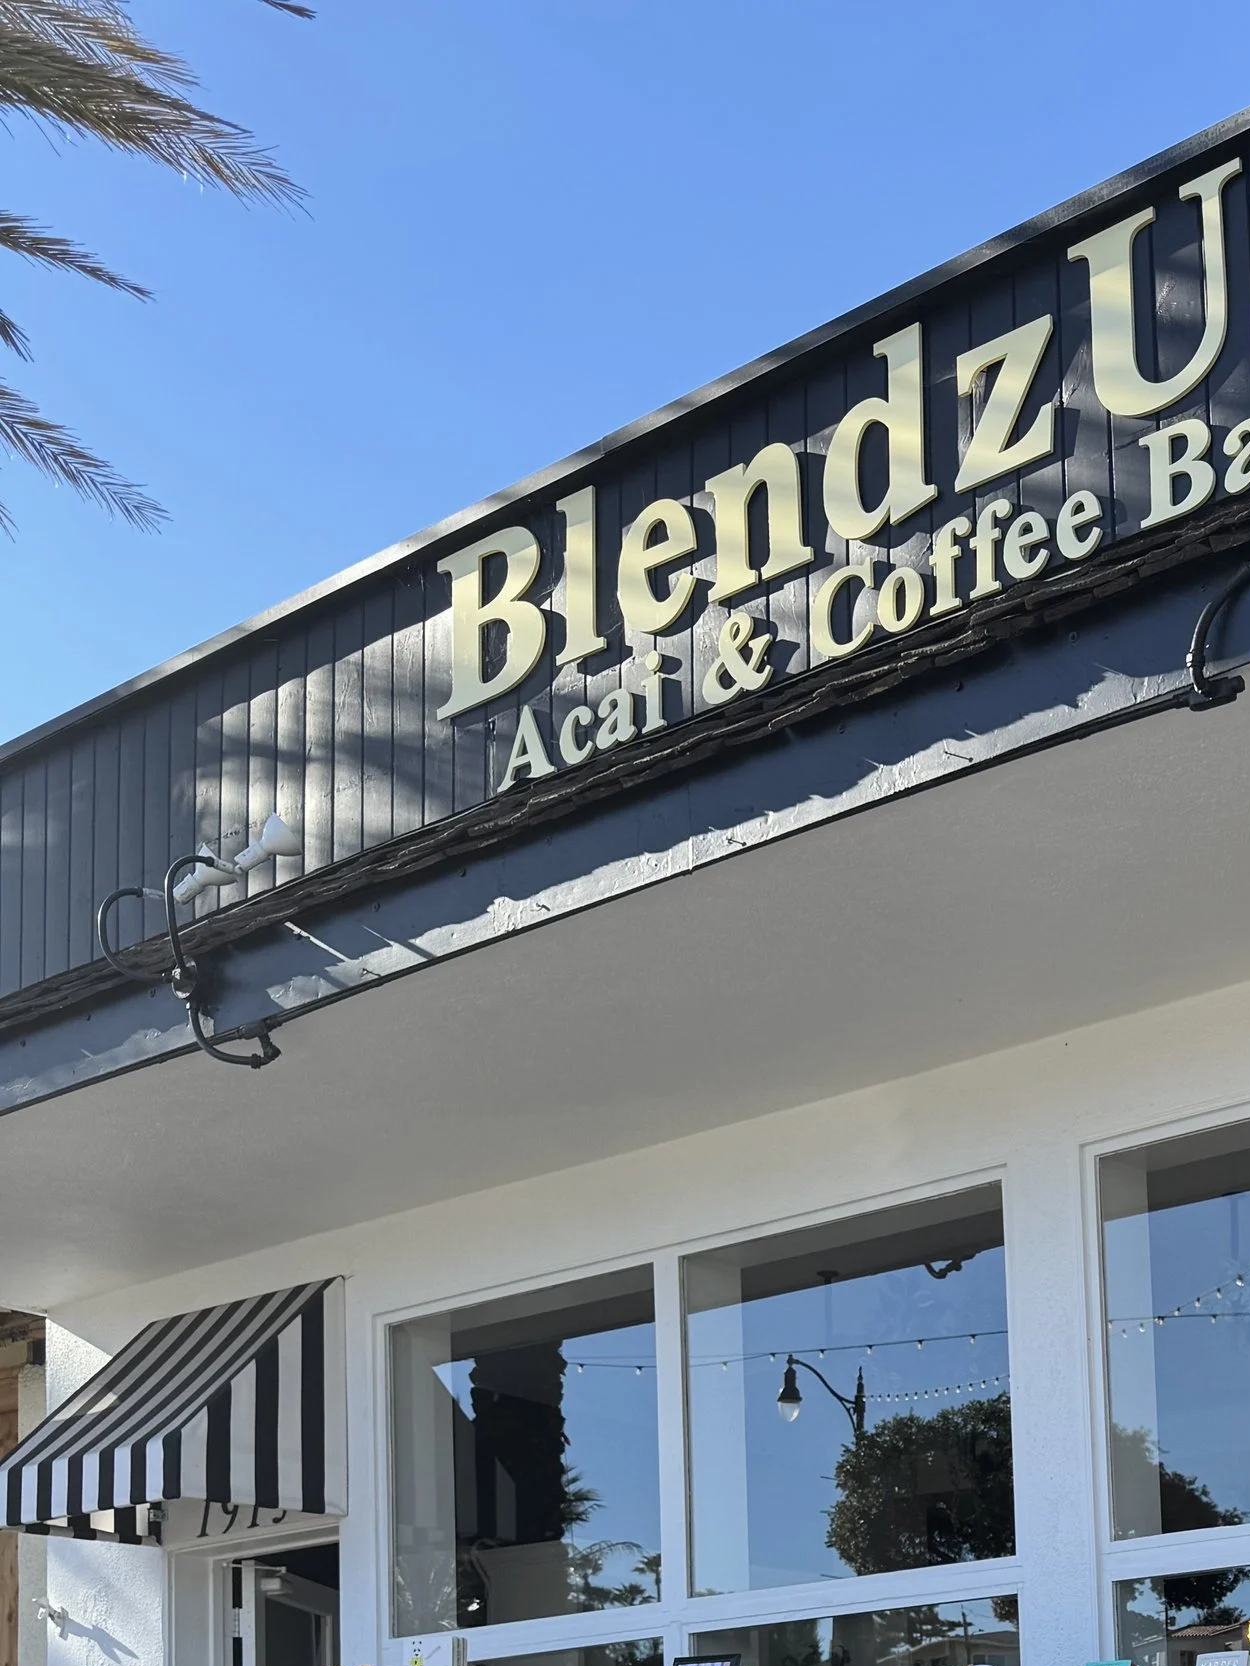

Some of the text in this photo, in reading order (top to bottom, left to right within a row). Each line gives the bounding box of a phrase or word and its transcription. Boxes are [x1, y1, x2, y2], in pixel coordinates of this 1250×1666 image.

[497, 653, 669, 793] Acai
[704, 610, 774, 706] &
[813, 490, 1104, 659] Coffee
